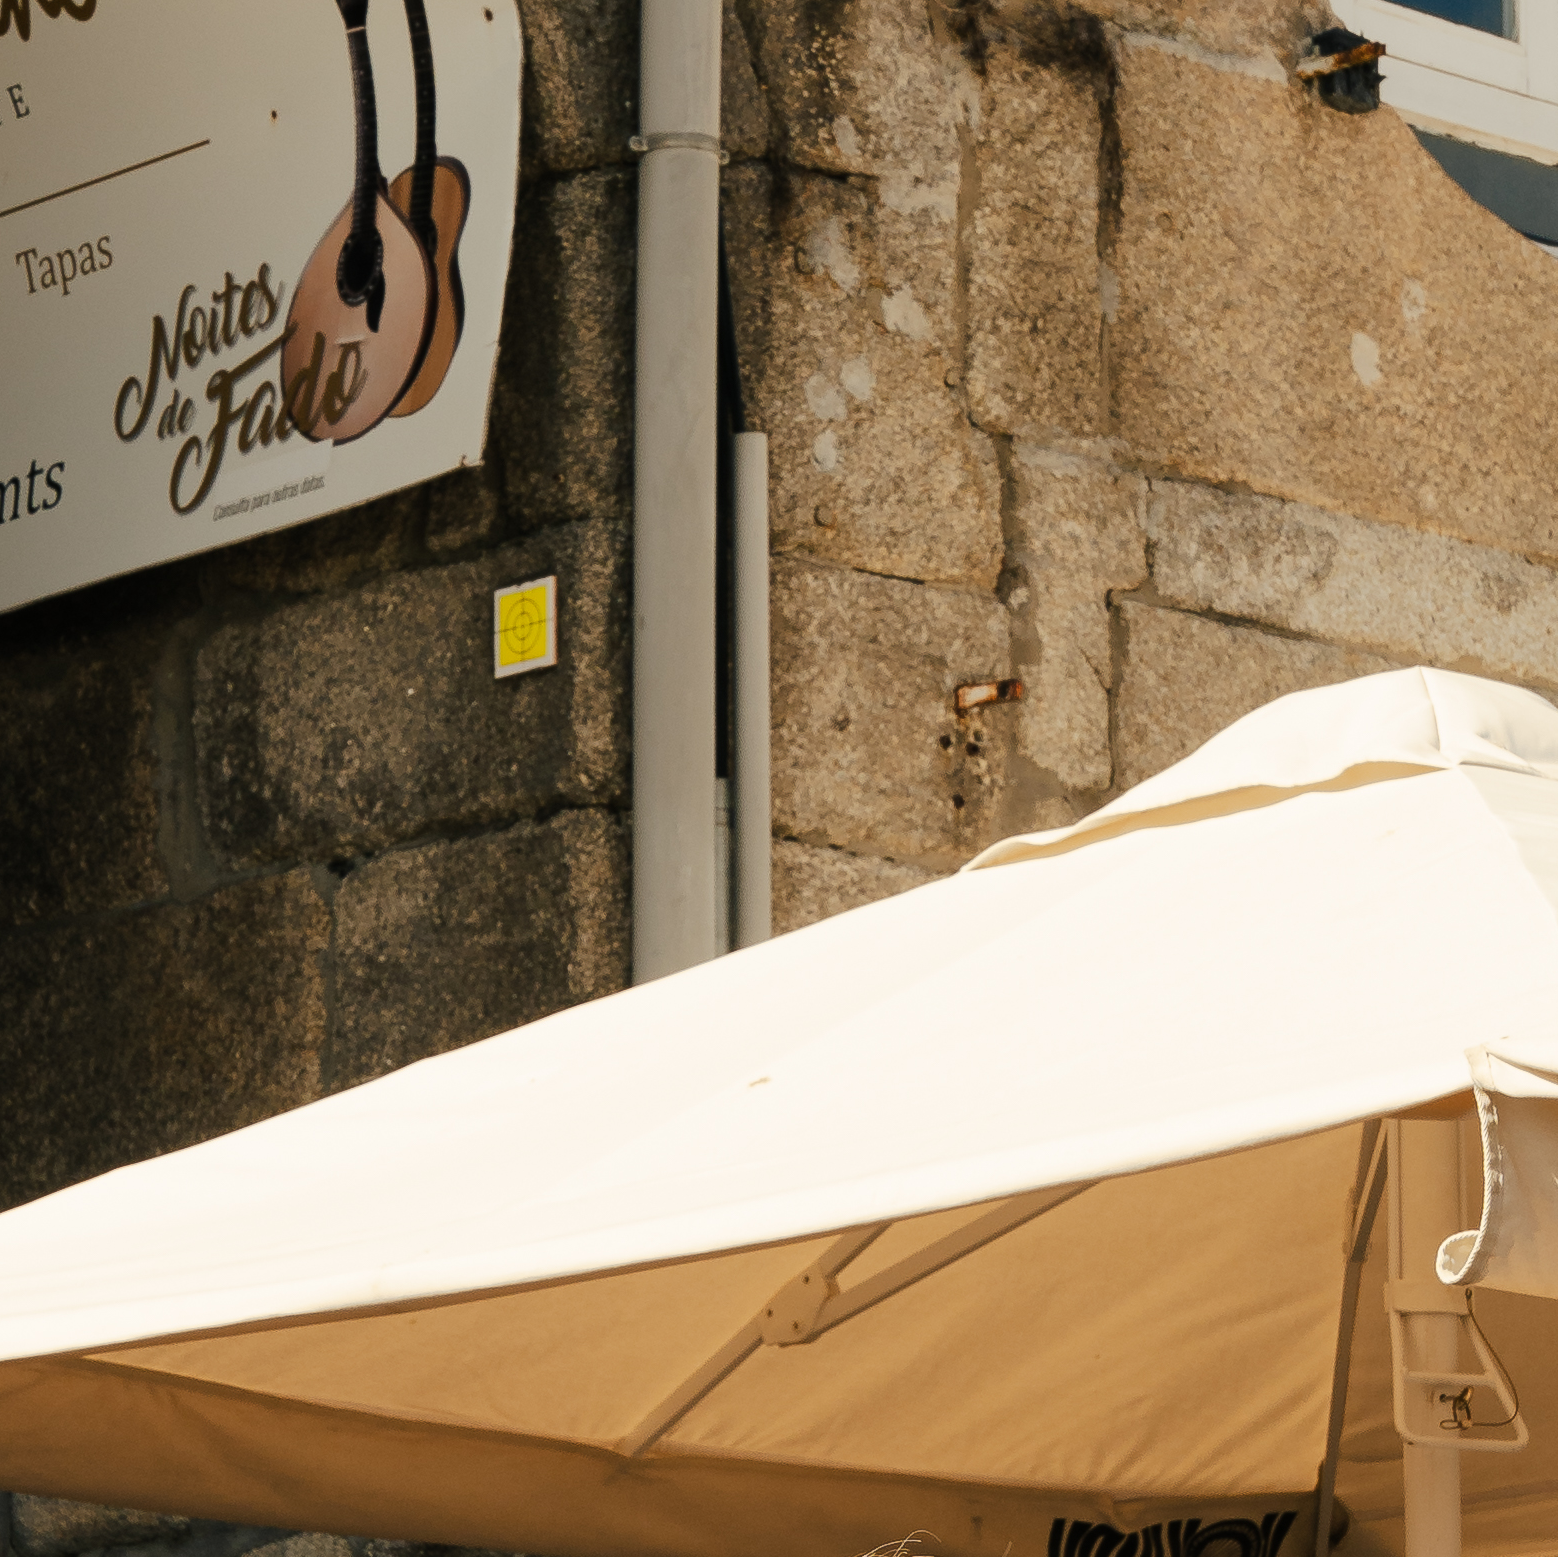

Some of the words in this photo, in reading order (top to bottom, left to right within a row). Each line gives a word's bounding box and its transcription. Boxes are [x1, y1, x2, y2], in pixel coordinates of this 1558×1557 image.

[15, 234, 113, 296] Tapas
[114, 262, 287, 442] Noites
[156, 388, 195, 440] de
[169, 321, 369, 516] Fado
